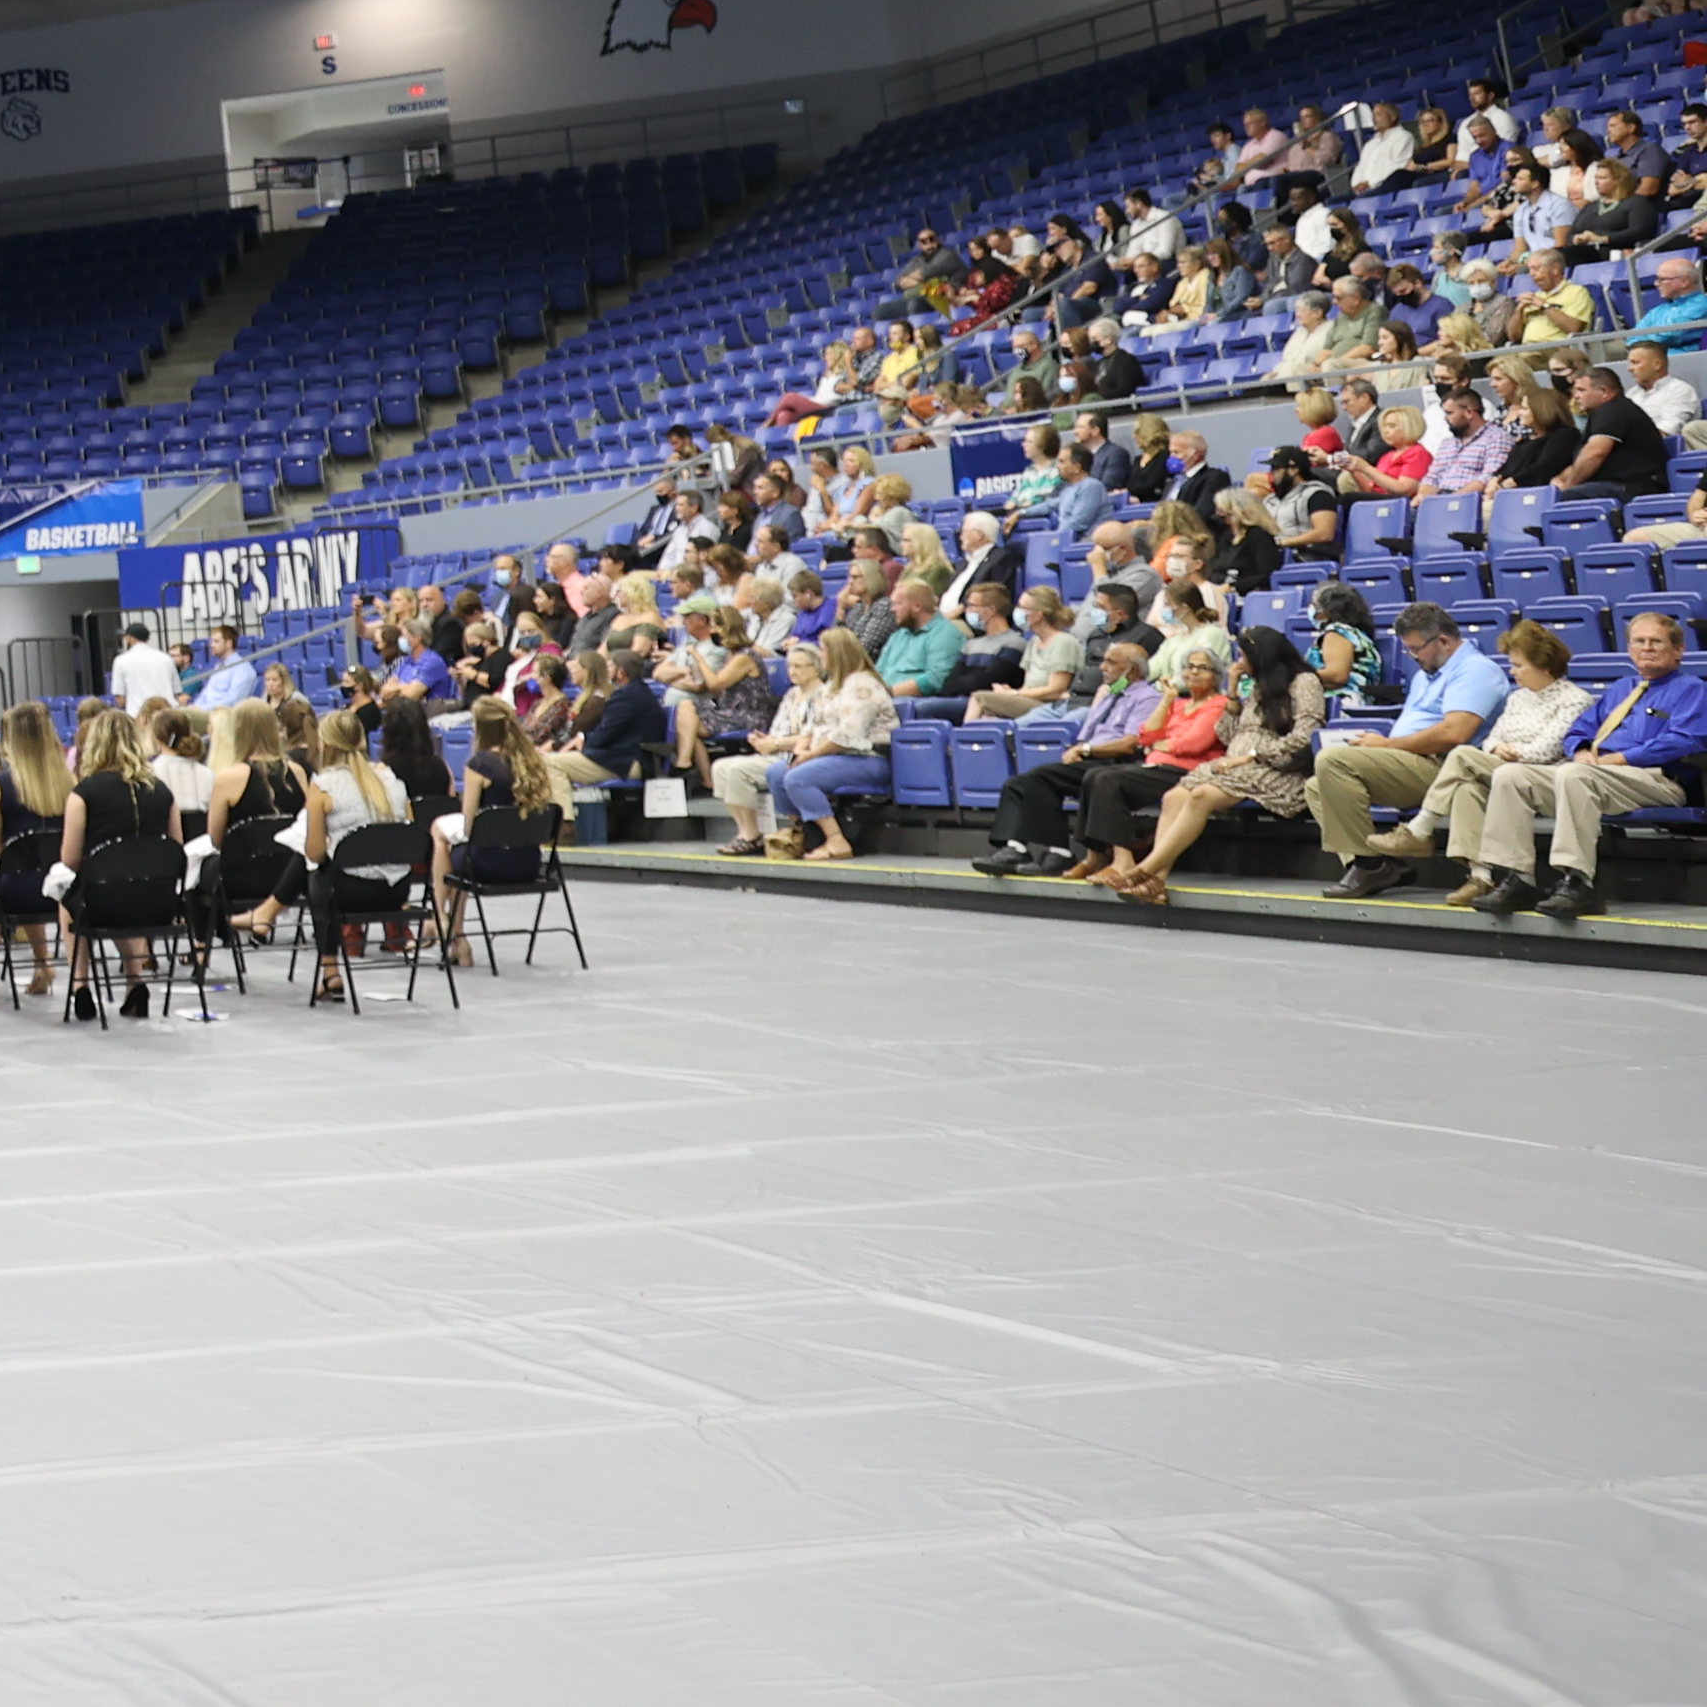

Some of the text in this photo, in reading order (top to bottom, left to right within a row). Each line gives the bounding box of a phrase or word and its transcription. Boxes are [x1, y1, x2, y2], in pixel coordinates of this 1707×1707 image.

[321, 55, 338, 75] S
[388, 97, 449, 115] CONCESSION
[25, 522, 139, 551] BASKETBALL
[181, 530, 360, 621] ABE'S ARMY
